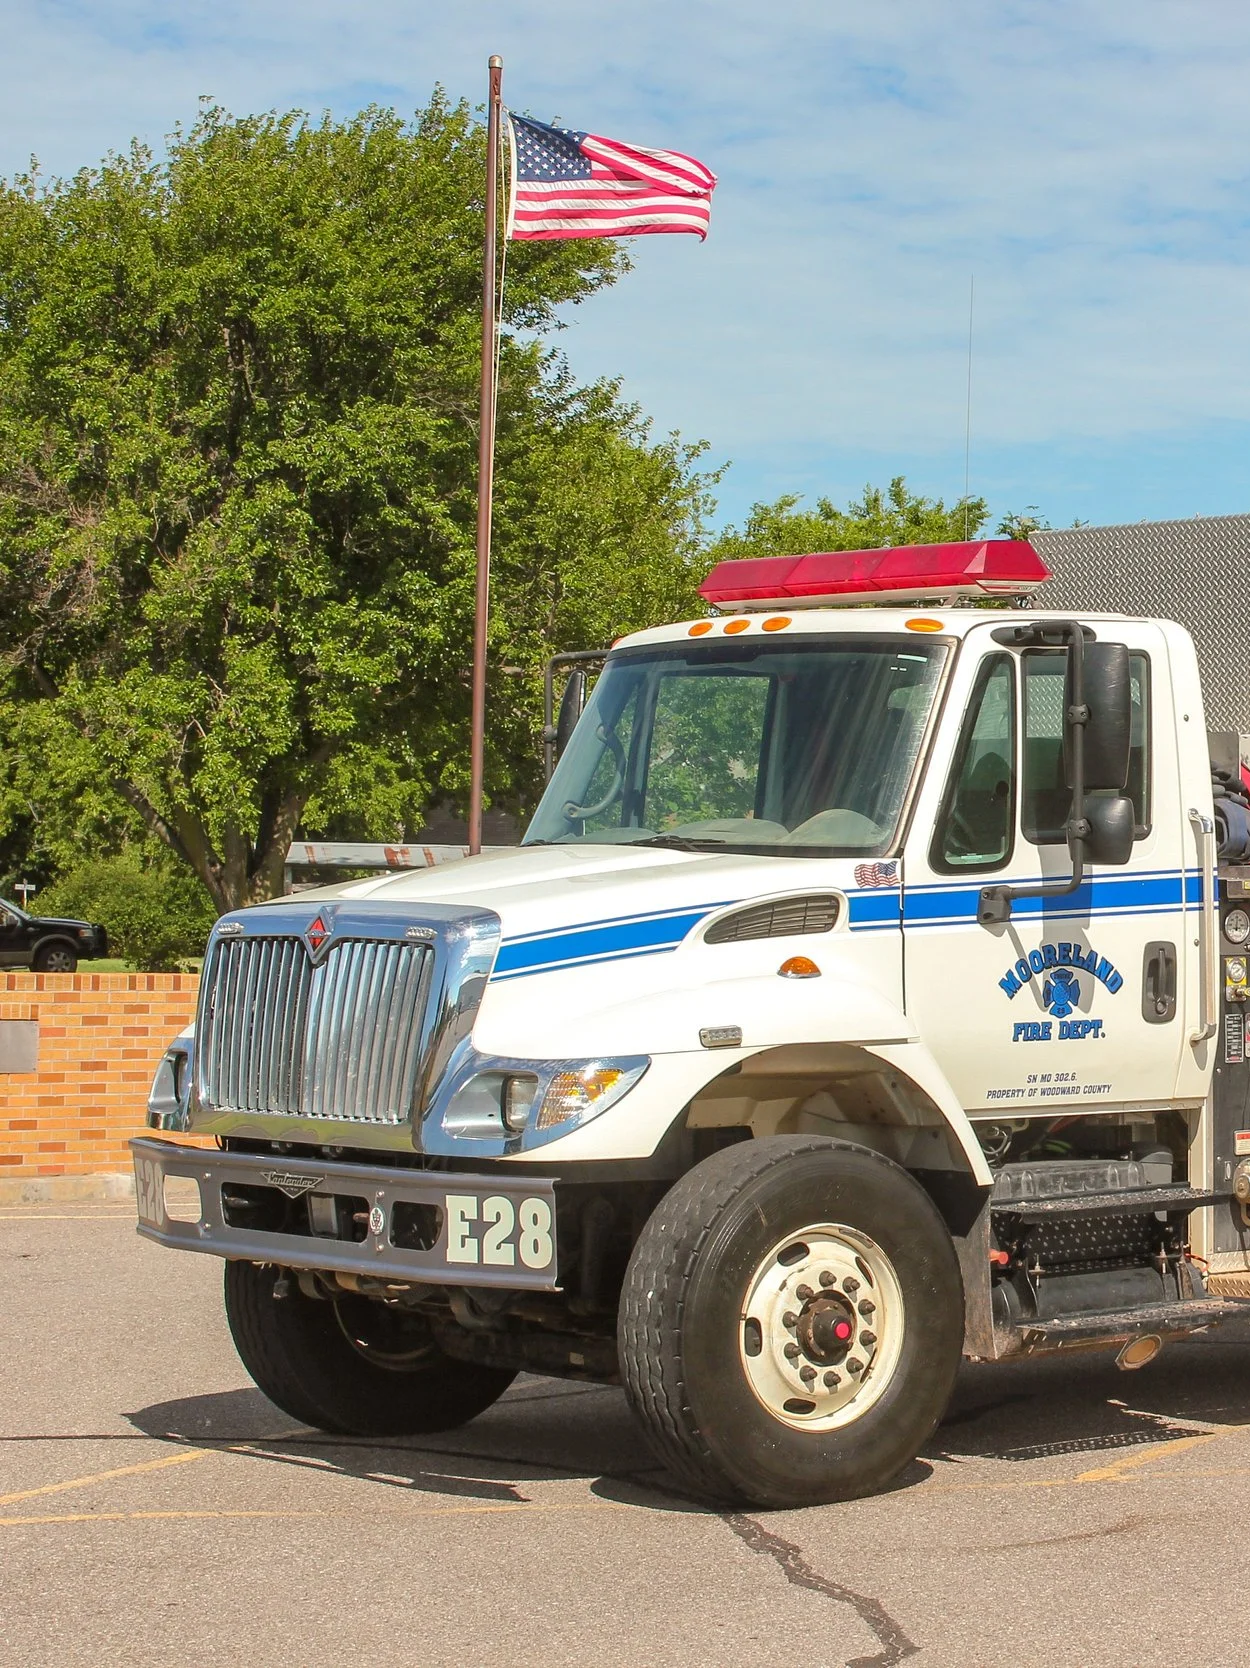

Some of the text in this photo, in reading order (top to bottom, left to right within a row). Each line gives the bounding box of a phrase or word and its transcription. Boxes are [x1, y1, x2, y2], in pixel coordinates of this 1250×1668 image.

[998, 943, 1124, 1000] MOORELAND
[1012, 1019, 1106, 1042] FIRE DEPT.
[986, 1084, 1112, 1099] PROPERTY OF WOODWARD COUNTY
[1027, 1074, 1038, 1083] SN
[134, 1157, 164, 1226] E28
[445, 1194, 554, 1269] E28
